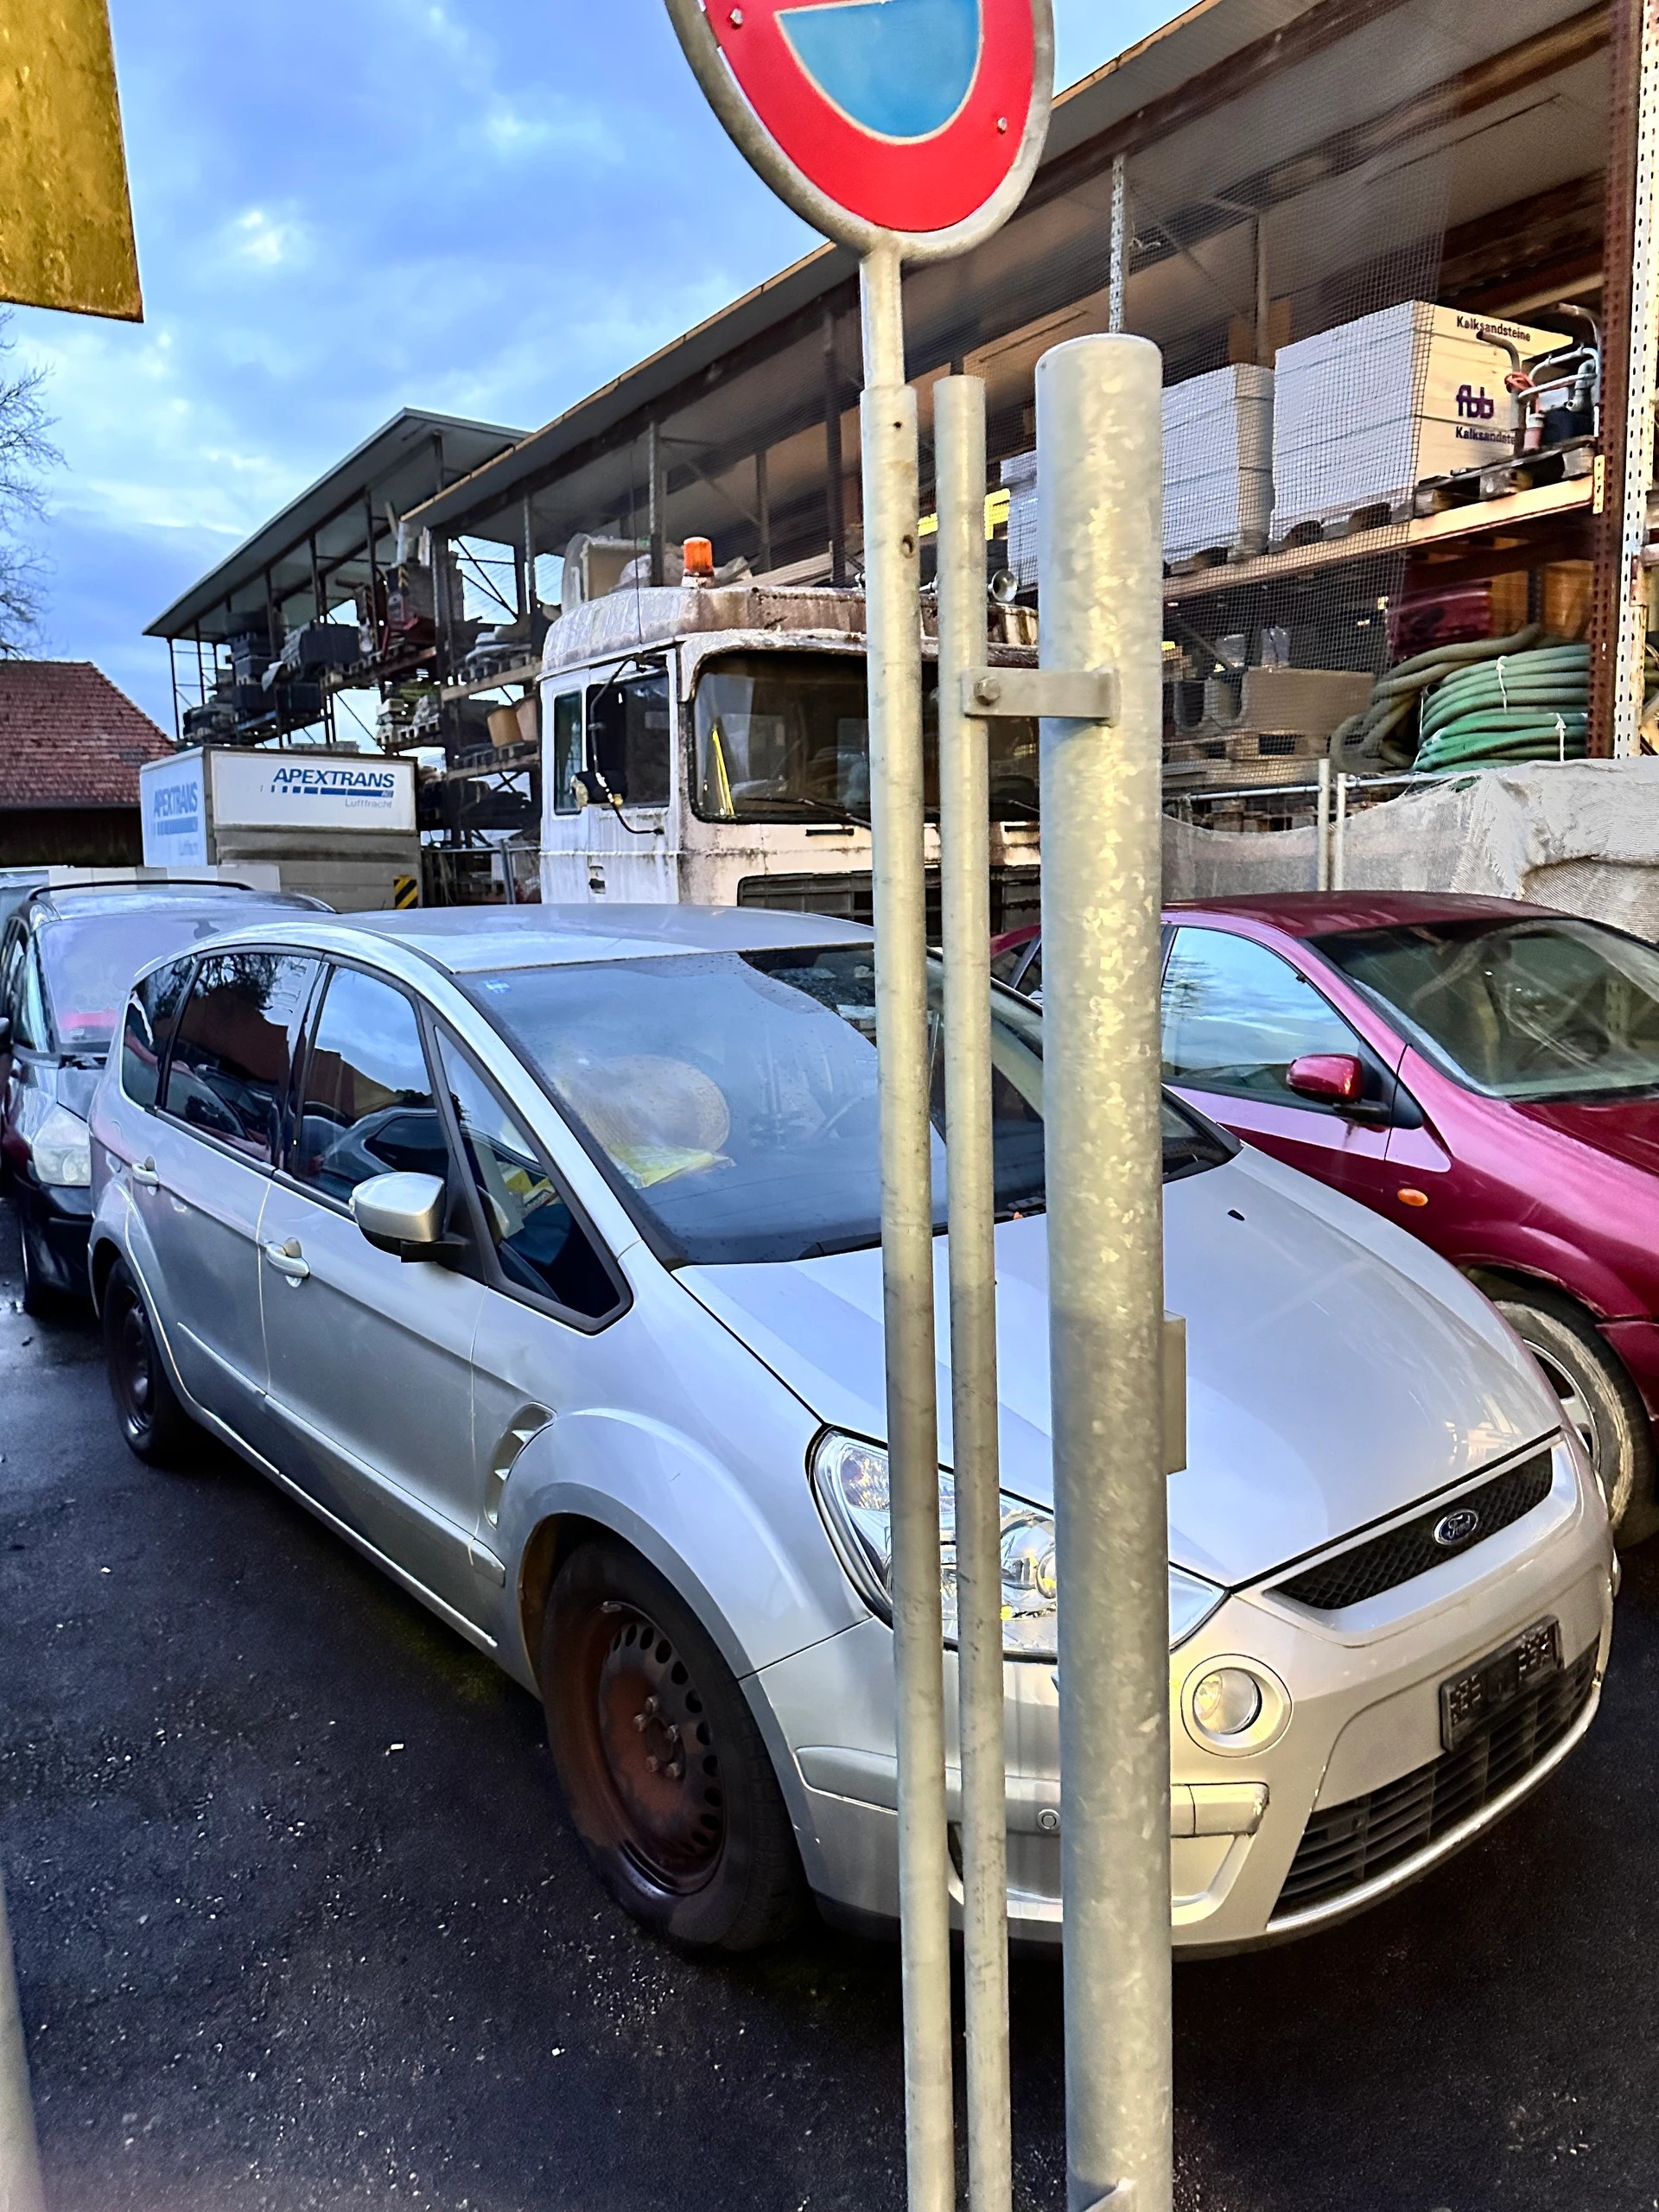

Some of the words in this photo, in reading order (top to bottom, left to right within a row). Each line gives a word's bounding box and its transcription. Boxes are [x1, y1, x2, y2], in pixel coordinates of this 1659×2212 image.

[1456, 315, 1531, 342] Kalksandsteine
[1456, 426, 1516, 445] Kalksandste
[273, 768, 395, 788] APEXTRANS
[345, 798, 392, 809] Luftfracht
[1447, 1515, 1471, 1538] Ford
